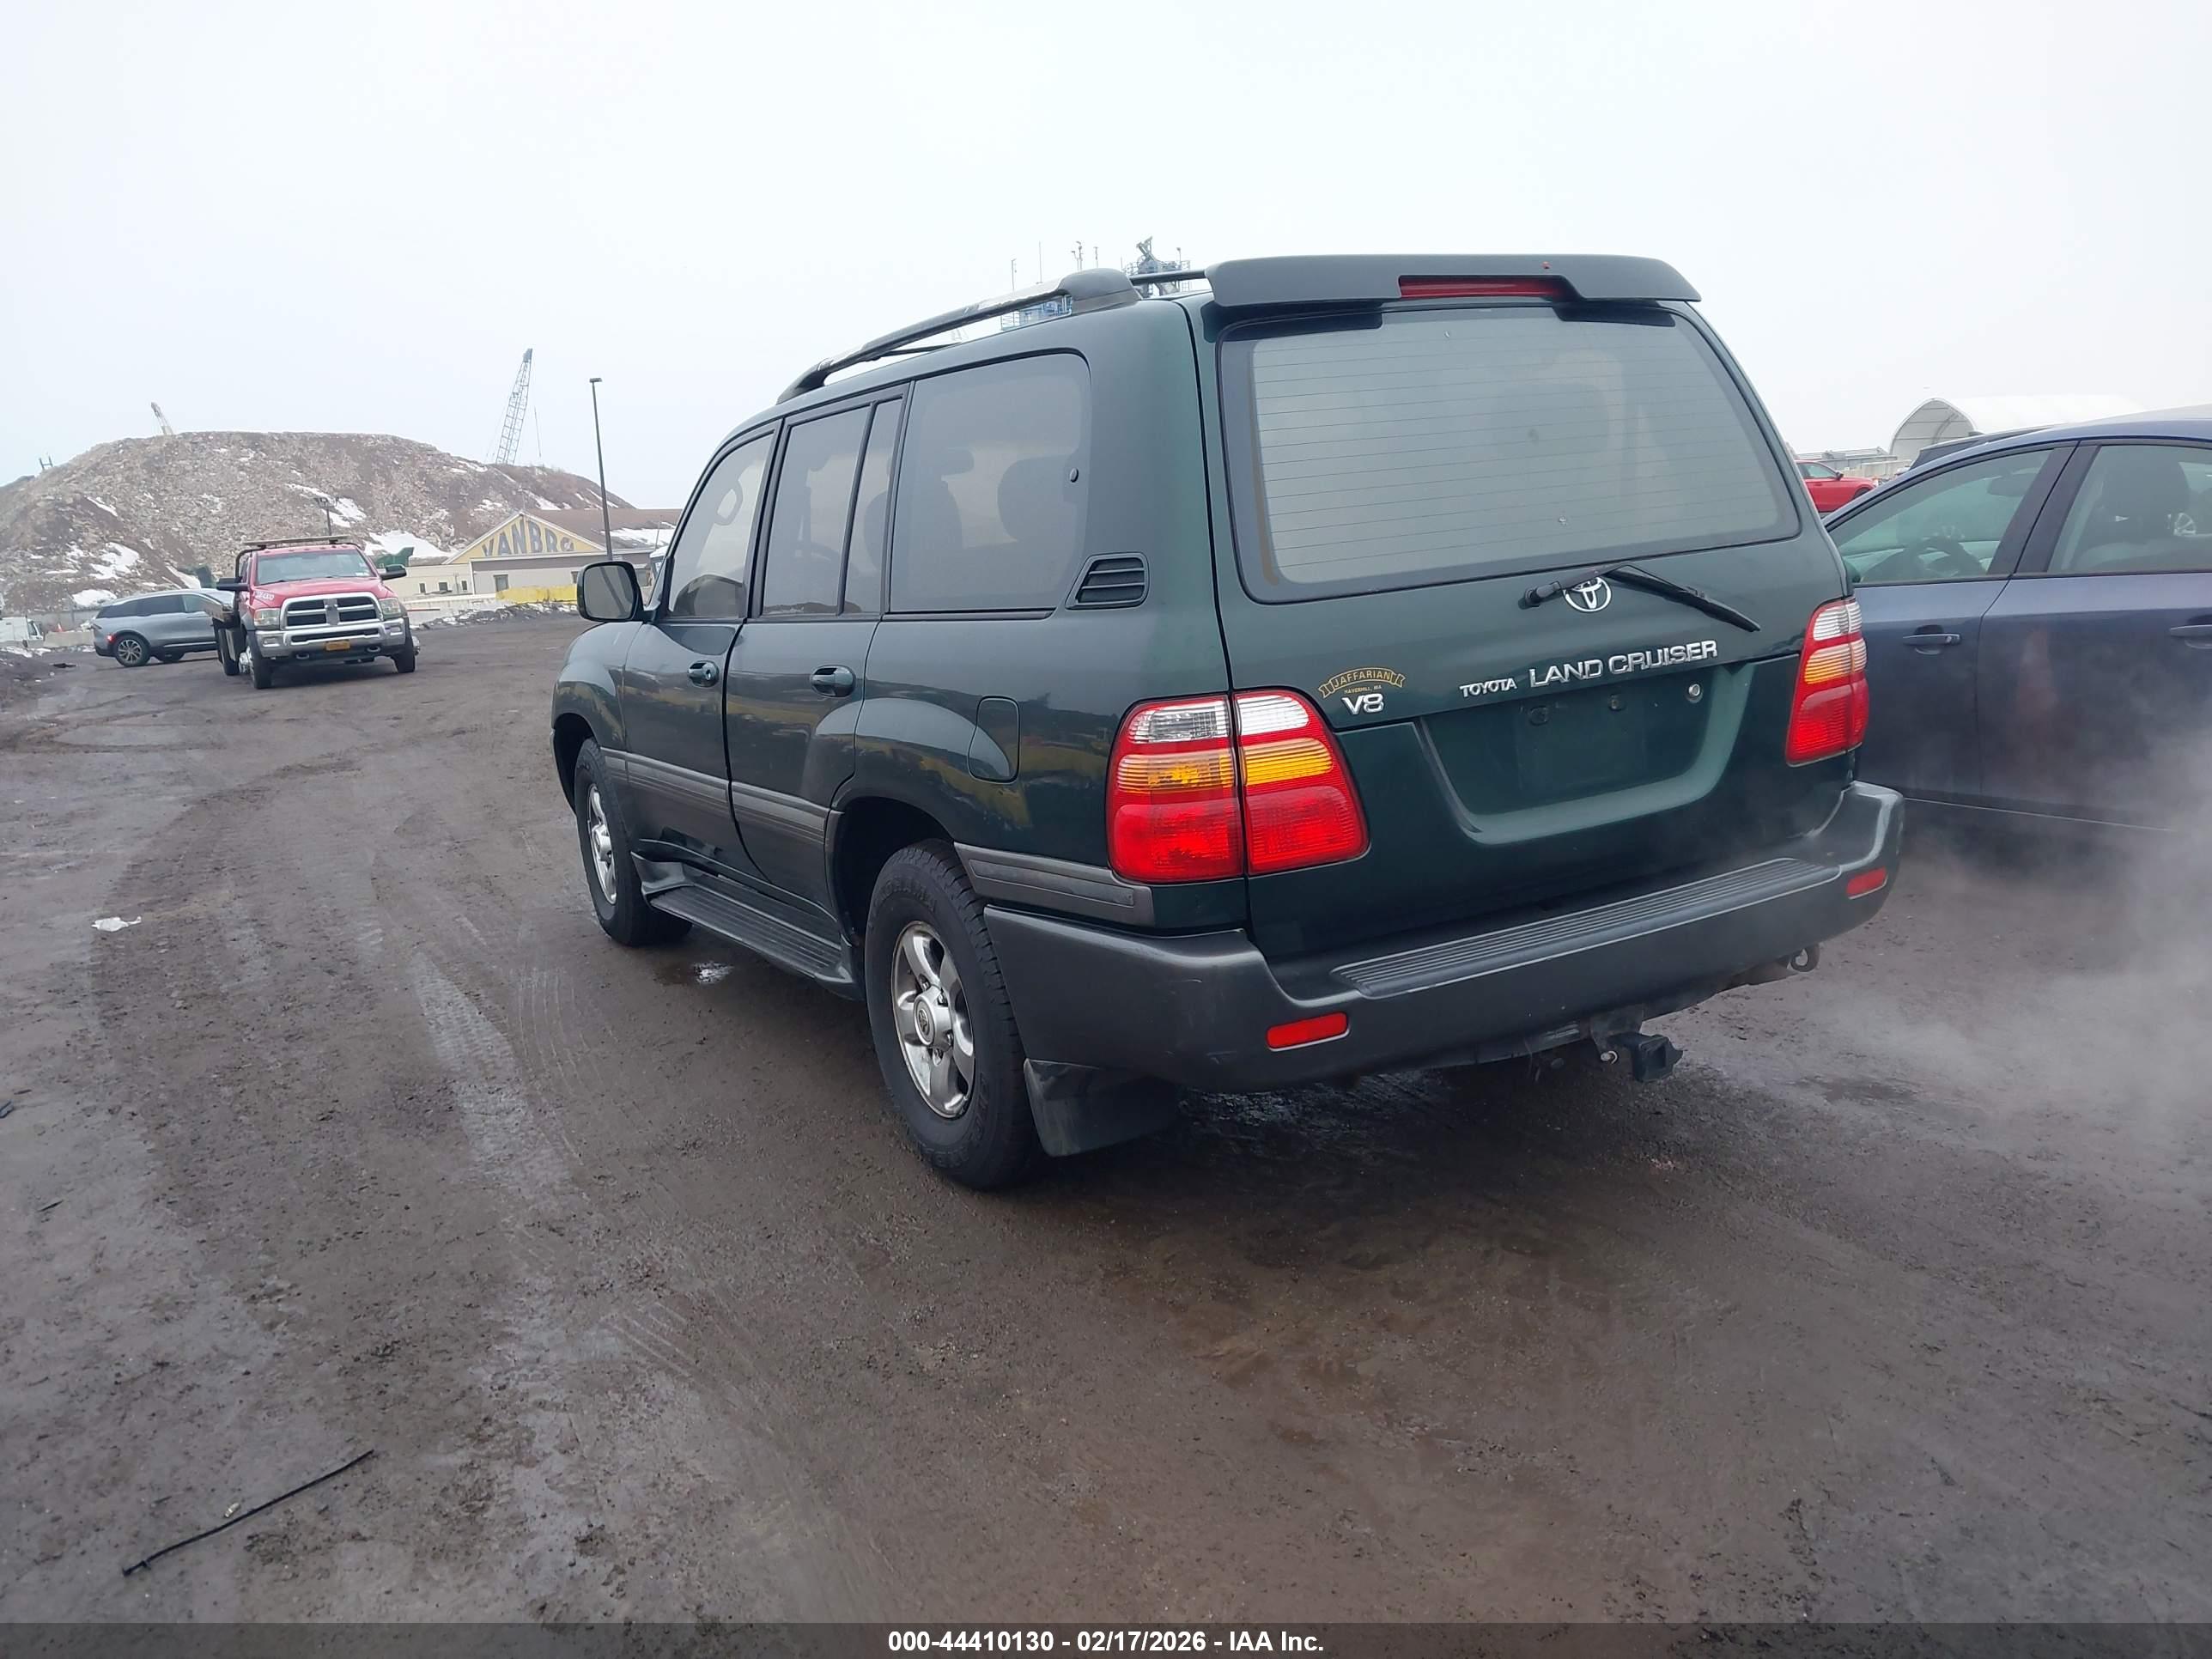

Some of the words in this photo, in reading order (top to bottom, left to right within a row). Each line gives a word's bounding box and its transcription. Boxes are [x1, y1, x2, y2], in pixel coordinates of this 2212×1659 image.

[1334, 670, 1391, 687] JAFFARIAN
[1460, 678, 1517, 697] TOYOTA
[1528, 659, 1603, 688] LAND
[1608, 640, 1718, 675] CRUISER
[1341, 693, 1384, 714] V8
